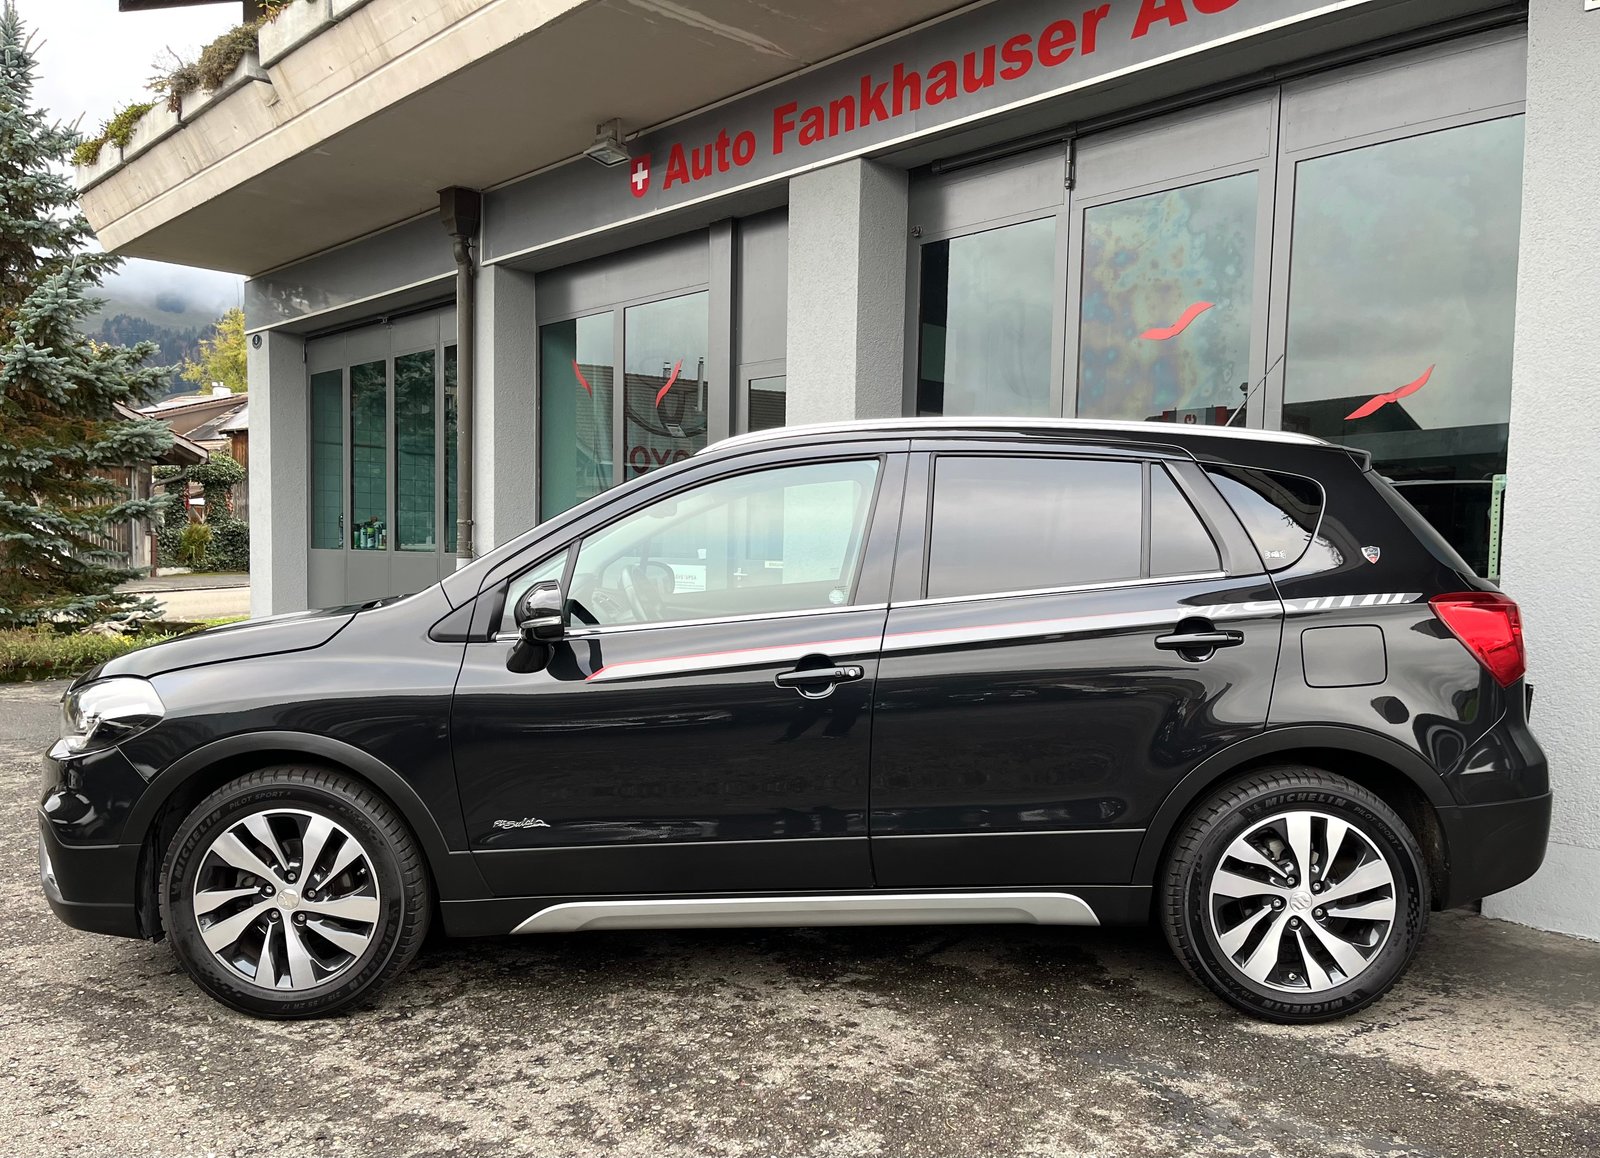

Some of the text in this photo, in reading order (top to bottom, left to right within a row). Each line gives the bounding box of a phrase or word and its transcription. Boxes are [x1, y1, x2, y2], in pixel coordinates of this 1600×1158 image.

[662, 0, 1240, 191] Auto Fankhauser A
[1265, 793, 1347, 808] MICHELIN
[174, 810, 222, 878] MICHELIN
